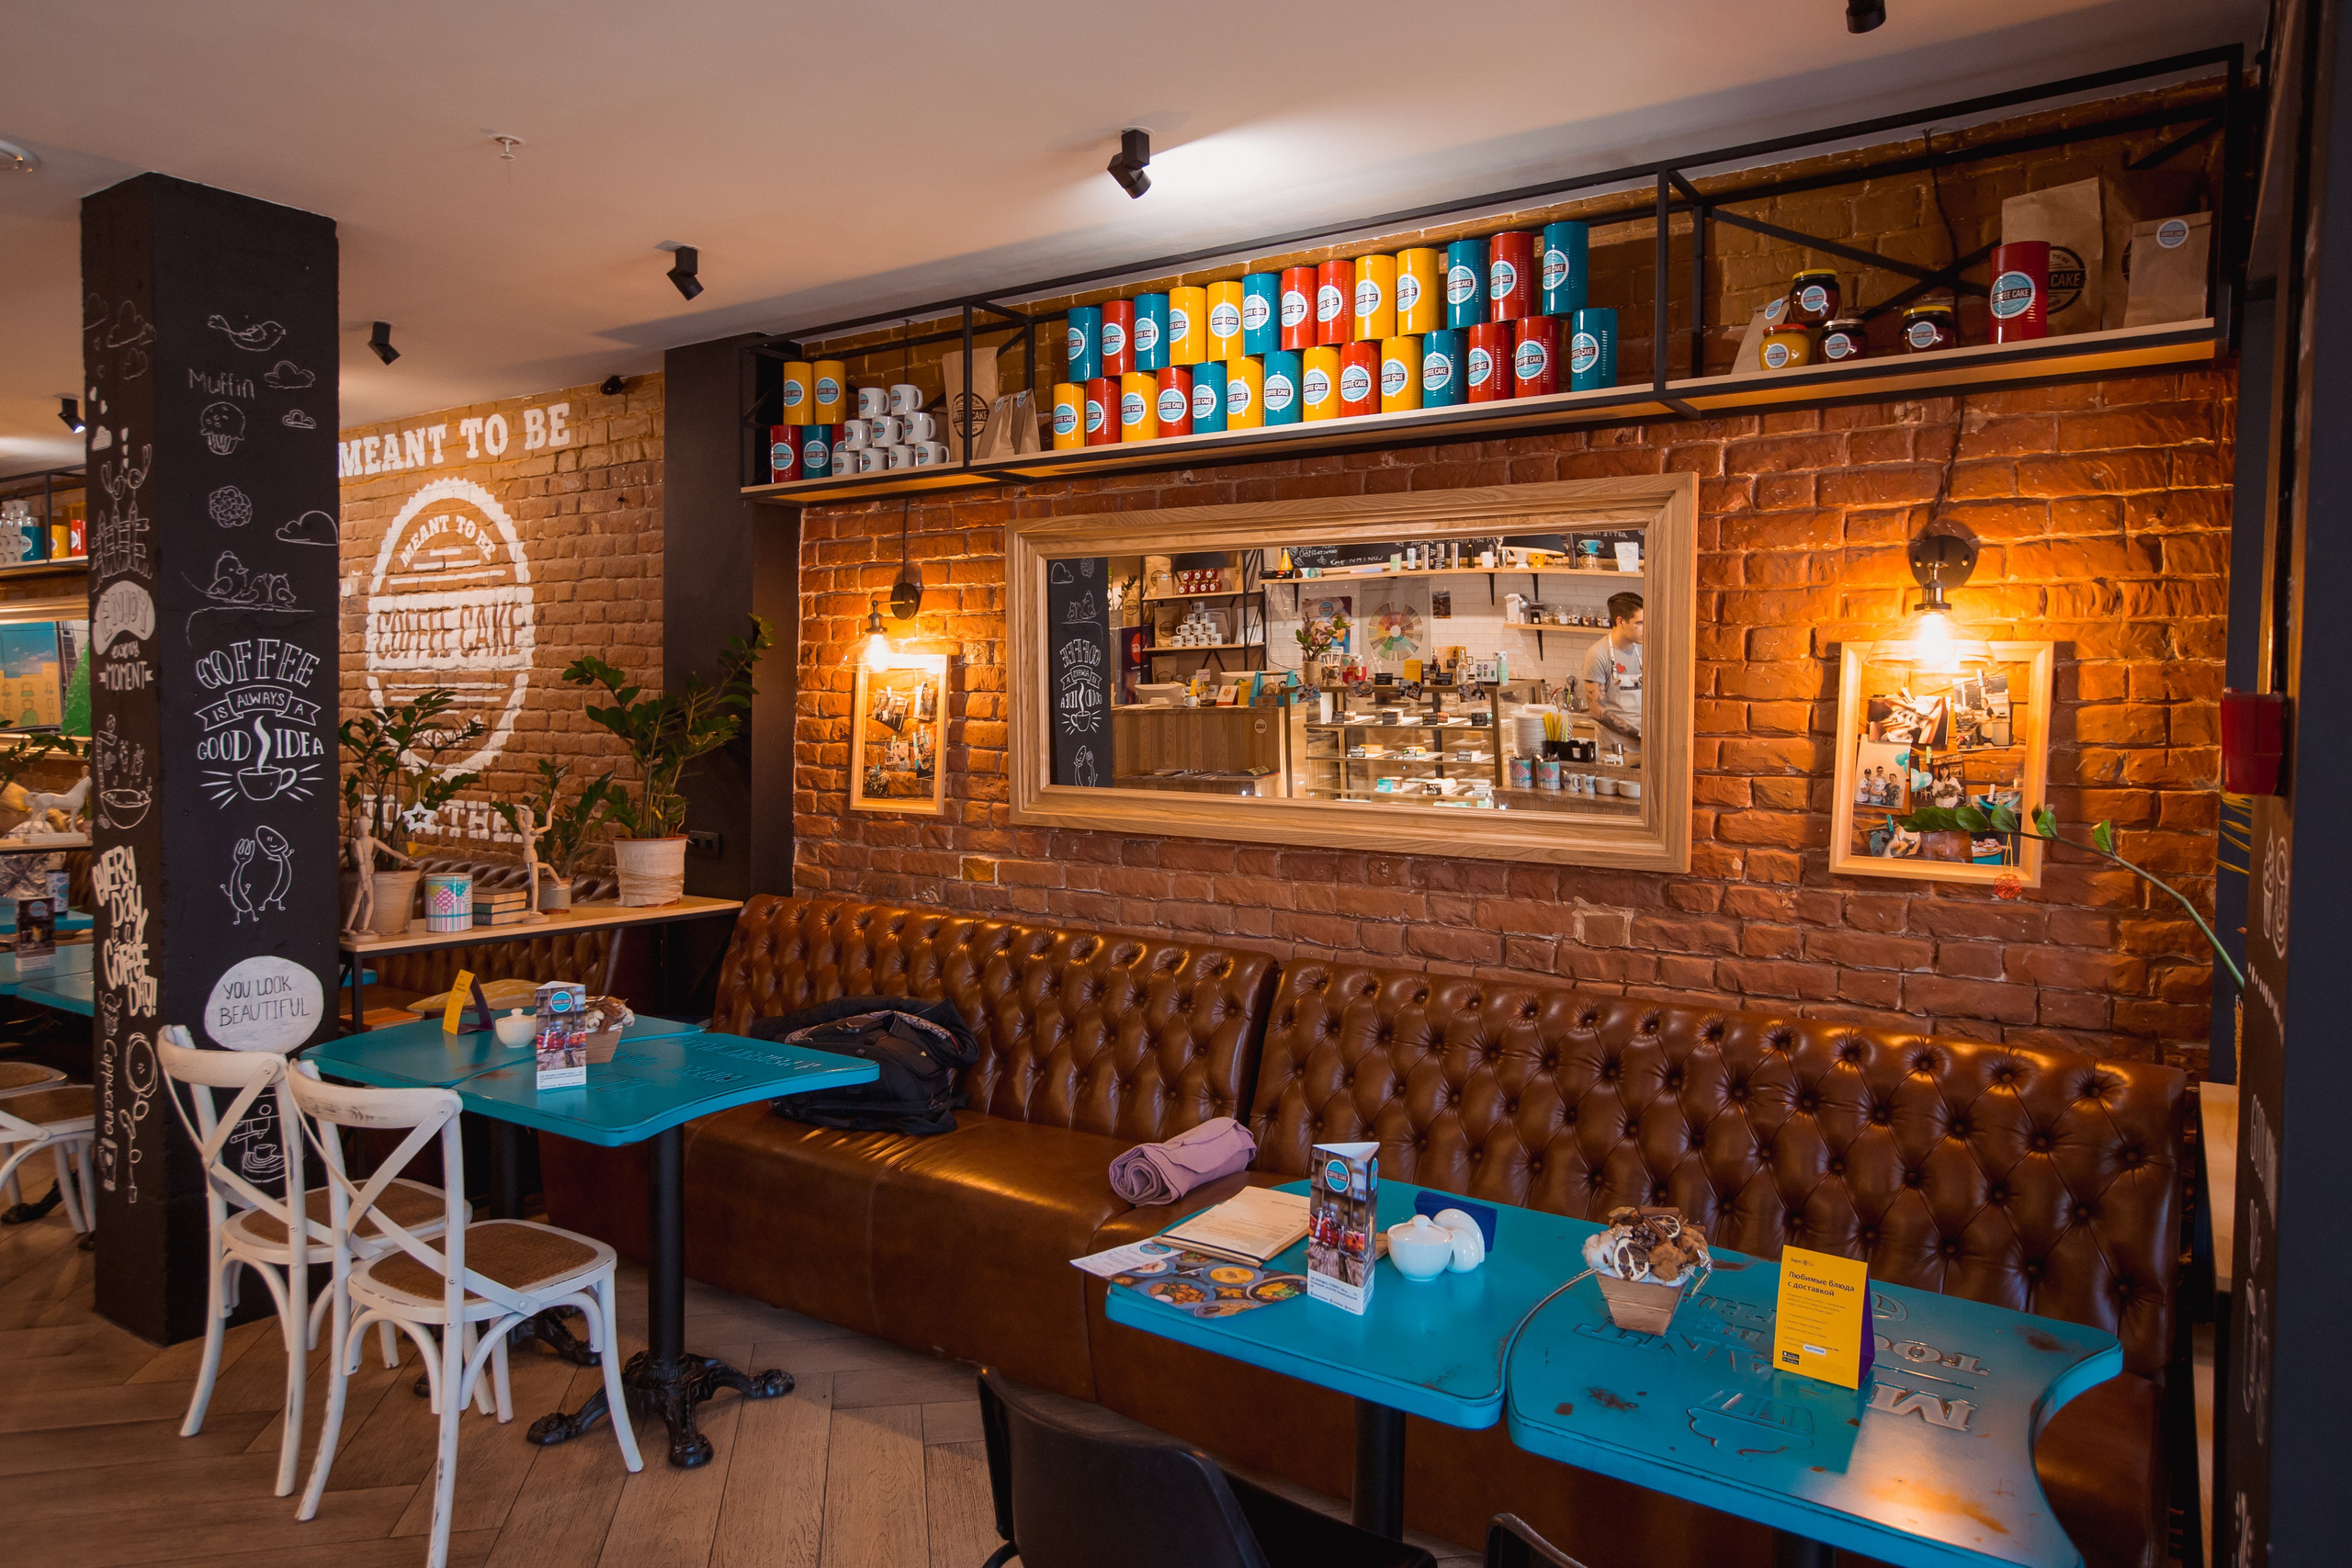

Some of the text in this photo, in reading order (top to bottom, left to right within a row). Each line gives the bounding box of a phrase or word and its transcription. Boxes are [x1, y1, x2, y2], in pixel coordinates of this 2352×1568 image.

[1460, 279, 1472, 288] CAKE
[1500, 275, 1512, 283] AKE
[2051, 273, 2081, 288] CAKE
[1406, 288, 1416, 297] CKE
[2012, 288, 2030, 299] CAKE
[1327, 297, 1339, 306] CKE
[1212, 317, 1238, 325] COFFE CAKE
[1529, 355, 1543, 364] CAKE
[1392, 372, 1404, 380] CAKE
[1435, 367, 1447, 375] CAKE
[188, 368, 255, 400] Muffin
[1355, 378, 1367, 387] CAKE
[1159, 401, 1171, 410] COFFEE
[972, 411, 988, 421] CAKE
[339, 402, 571, 478] MEANT TO BE
[400, 514, 497, 568] MEANT TO BE
[100, 590, 149, 642] ENJOY
[376, 601, 523, 660] COFFEE CAKE
[196, 637, 322, 689] COFFEE
[106, 661, 147, 691] MOMENT
[212, 691, 304, 722] IS ALWAYS A
[198, 728, 325, 761] GOOD IDEA
[103, 939, 150, 990] COFFEE
[223, 976, 292, 1000] YOU LOOK
[220, 997, 311, 1027] BEAUTIFUL
[1788, 1270, 1855, 1292] Любимые блюда
[1792, 1282, 1835, 1297] доставкой
